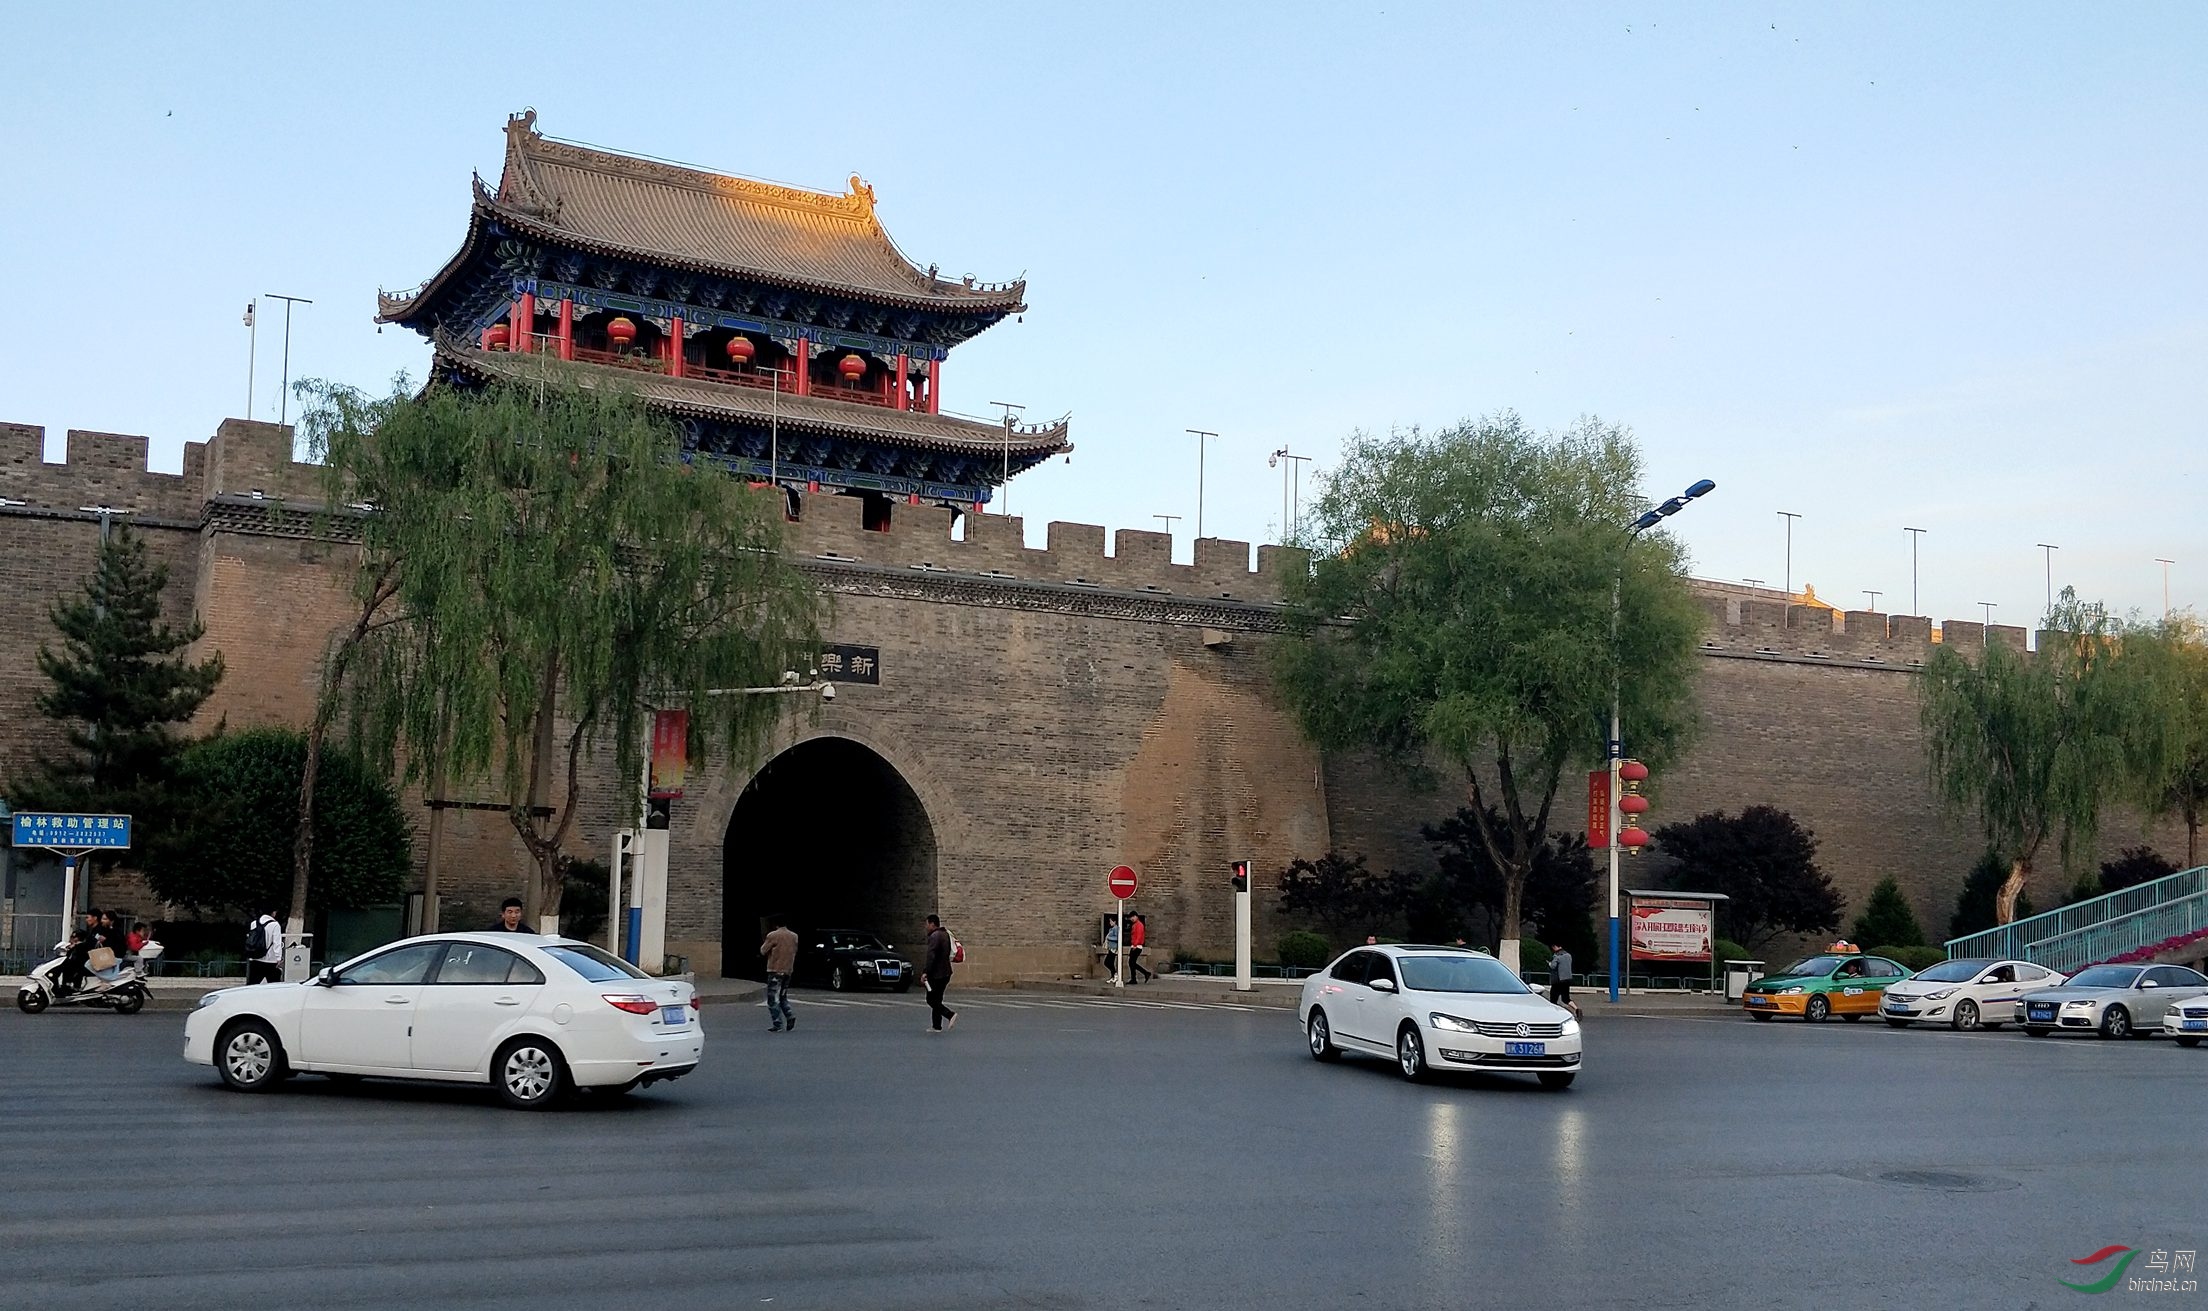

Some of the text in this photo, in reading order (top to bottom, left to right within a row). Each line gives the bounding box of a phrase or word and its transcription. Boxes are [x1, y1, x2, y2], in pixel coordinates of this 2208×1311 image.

[20, 816, 124, 829] 榆林救助管理站
